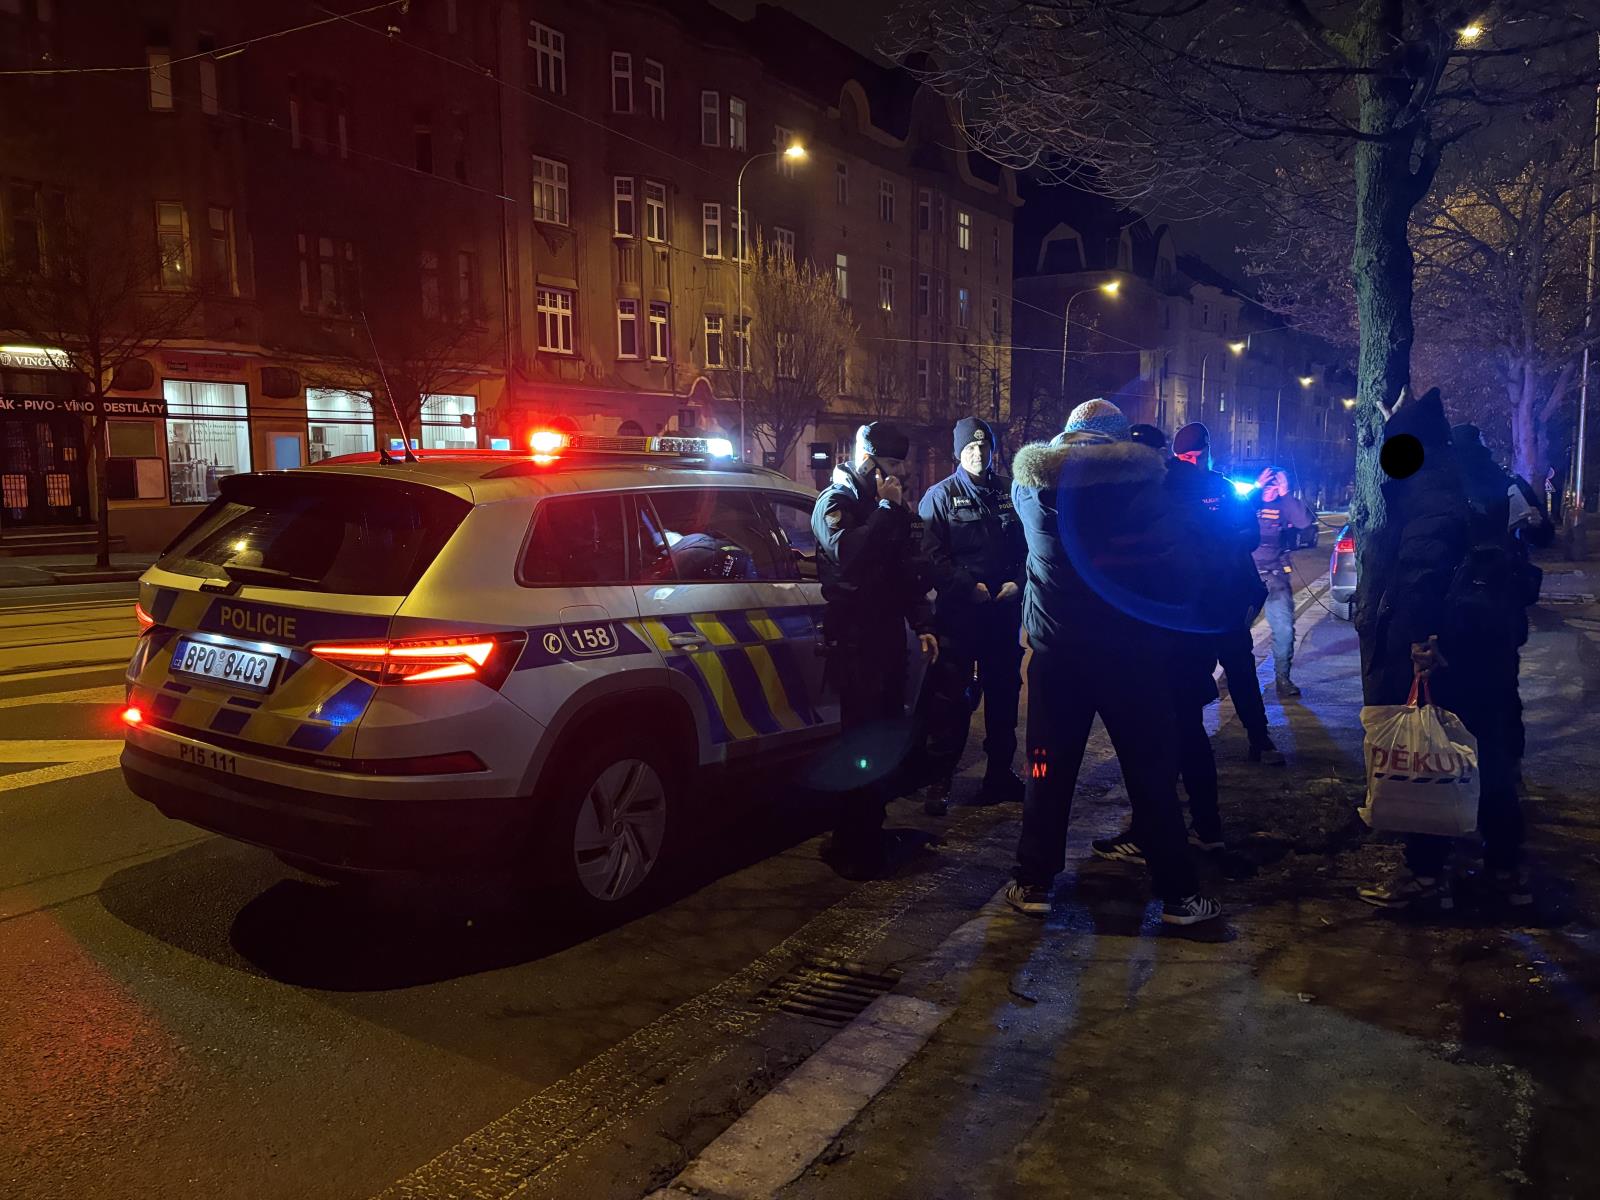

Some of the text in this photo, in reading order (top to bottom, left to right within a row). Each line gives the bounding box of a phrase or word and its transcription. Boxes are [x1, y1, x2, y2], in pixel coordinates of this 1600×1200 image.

[25, 400, 55, 411] PIVO
[64, 400, 95, 412] VÍNO
[103, 402, 165, 414] DESTILÁTY
[220, 605, 297, 639] POLICIE
[572, 627, 611, 649] 158
[184, 645, 268, 684] 8P0 8403
[179, 742, 237, 773] P15 111
